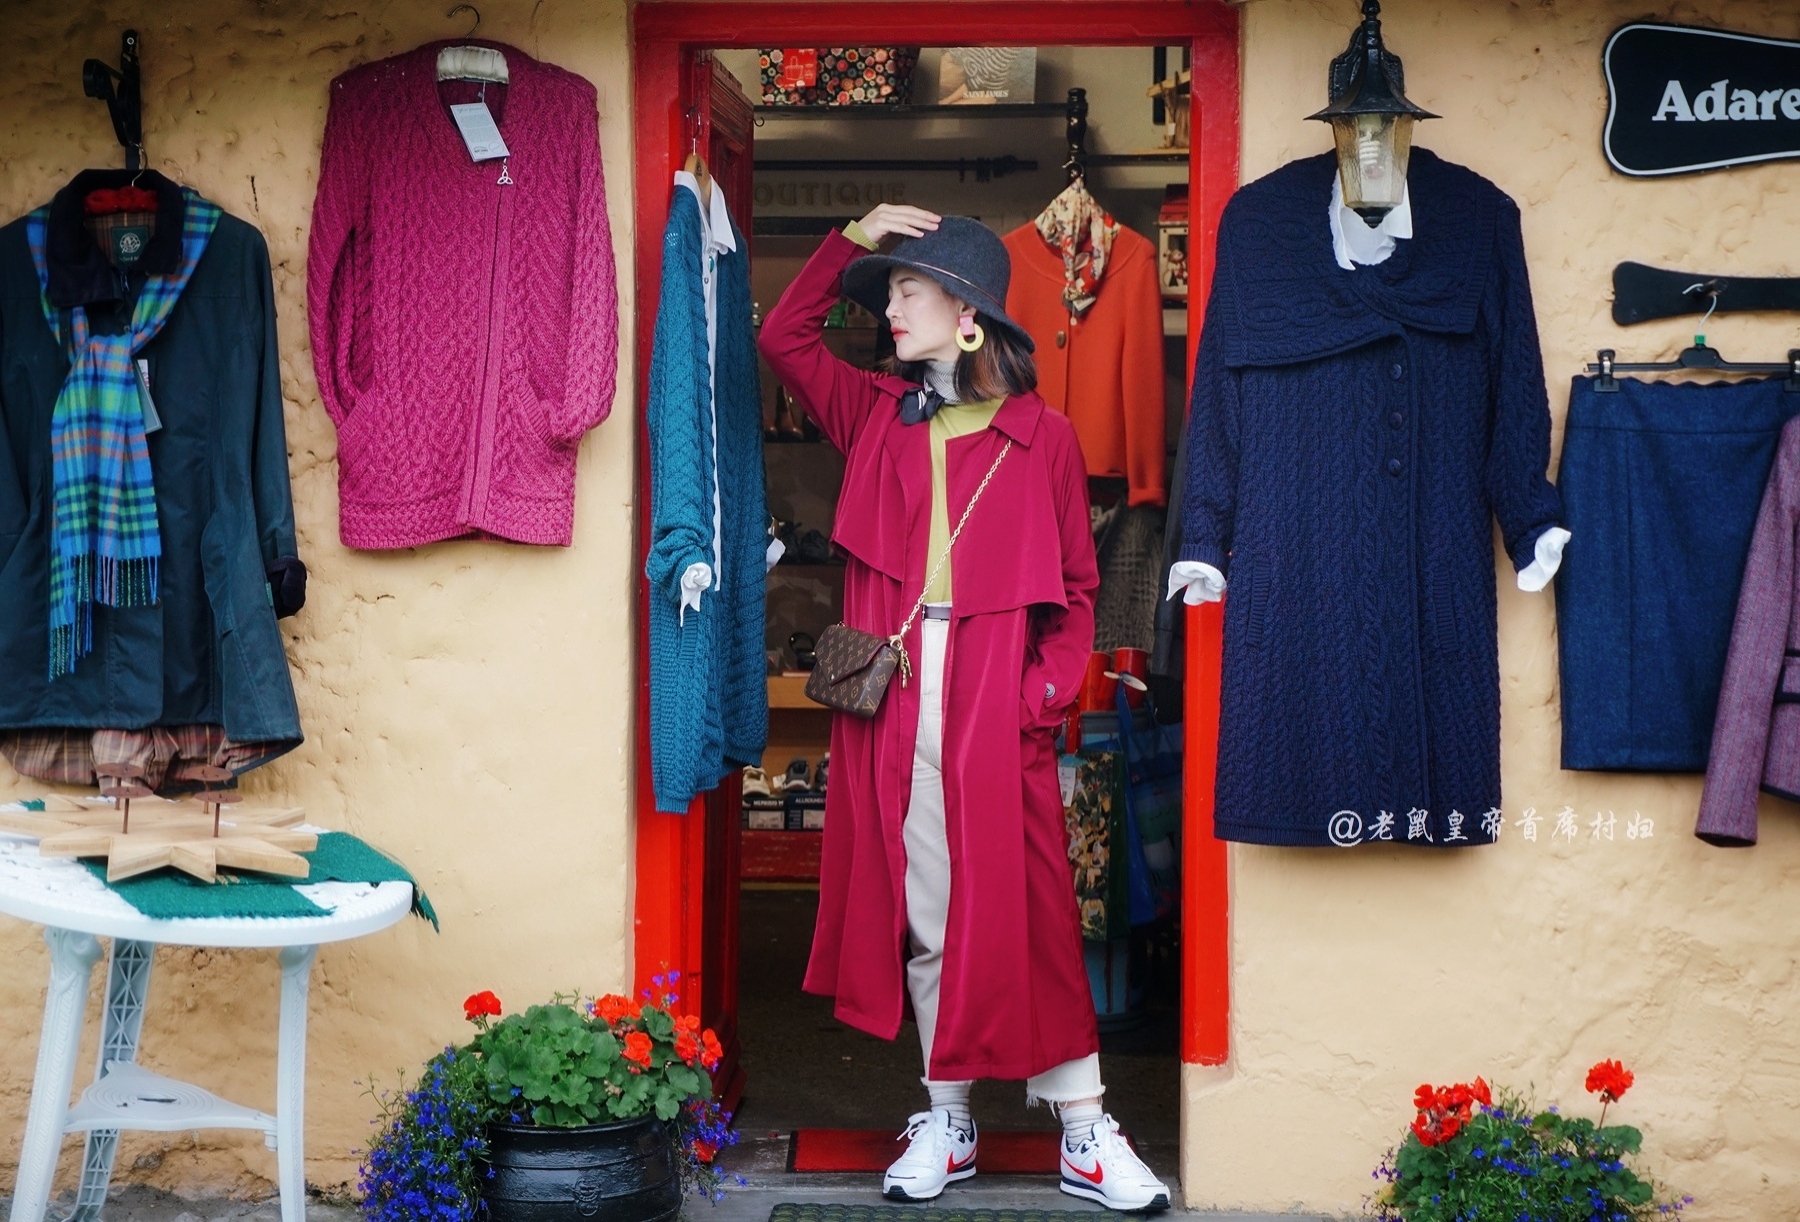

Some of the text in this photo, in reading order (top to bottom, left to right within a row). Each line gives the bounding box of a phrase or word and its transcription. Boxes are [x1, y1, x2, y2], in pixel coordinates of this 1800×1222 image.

[962, 89, 1009, 98] SAINT JAMES
[1652, 79, 1800, 122] Adare
